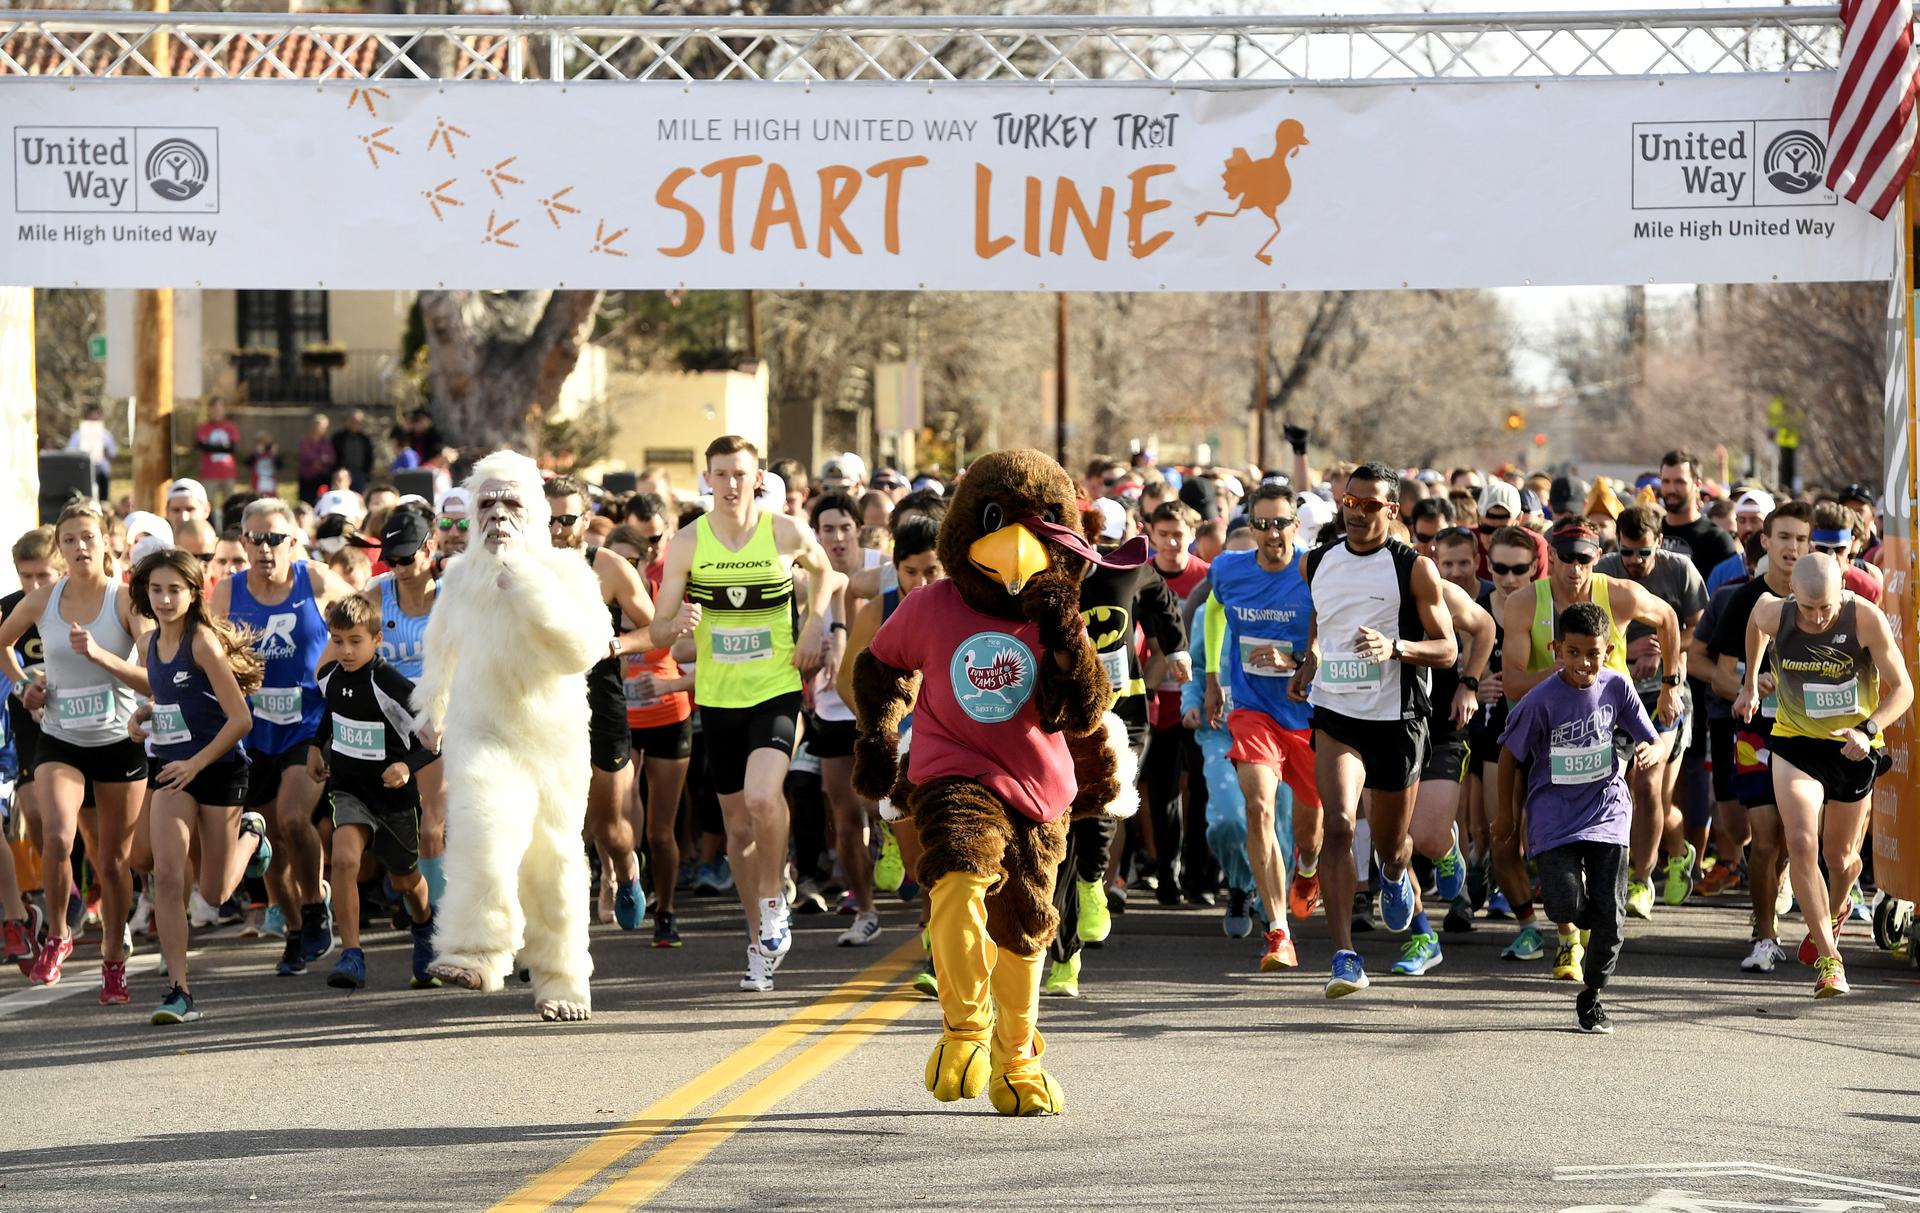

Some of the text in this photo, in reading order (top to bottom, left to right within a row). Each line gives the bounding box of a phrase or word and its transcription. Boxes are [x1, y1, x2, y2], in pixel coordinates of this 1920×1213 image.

[659, 119, 721, 141] MILE
[735, 119, 800, 141] HIGH
[813, 119, 914, 142] UNITED
[924, 119, 978, 142] WAY
[992, 112, 1098, 150] TURKEY
[20, 136, 129, 166] United
[1638, 130, 1748, 162] United
[63, 170, 129, 207] Way
[1680, 165, 1747, 202] Way
[655, 155, 1177, 261] START LINE
[18, 224, 217, 247] Mile High United Way
[1633, 217, 1836, 242] Mile High United Way
[716, 560, 772, 569] BROOKS
[723, 634, 760, 651] 9276
[970, 666, 1003, 677] RUN YOUR
[1329, 661, 1368, 679] 9460
[1782, 658, 1844, 674] Kansas City
[974, 670, 1013, 687] YAMS OFF
[67, 695, 104, 716] 3076
[261, 695, 294, 713] 1969
[1816, 690, 1853, 707] 8639
[340, 725, 374, 746] 9644
[1564, 752, 1602, 772] 9528
